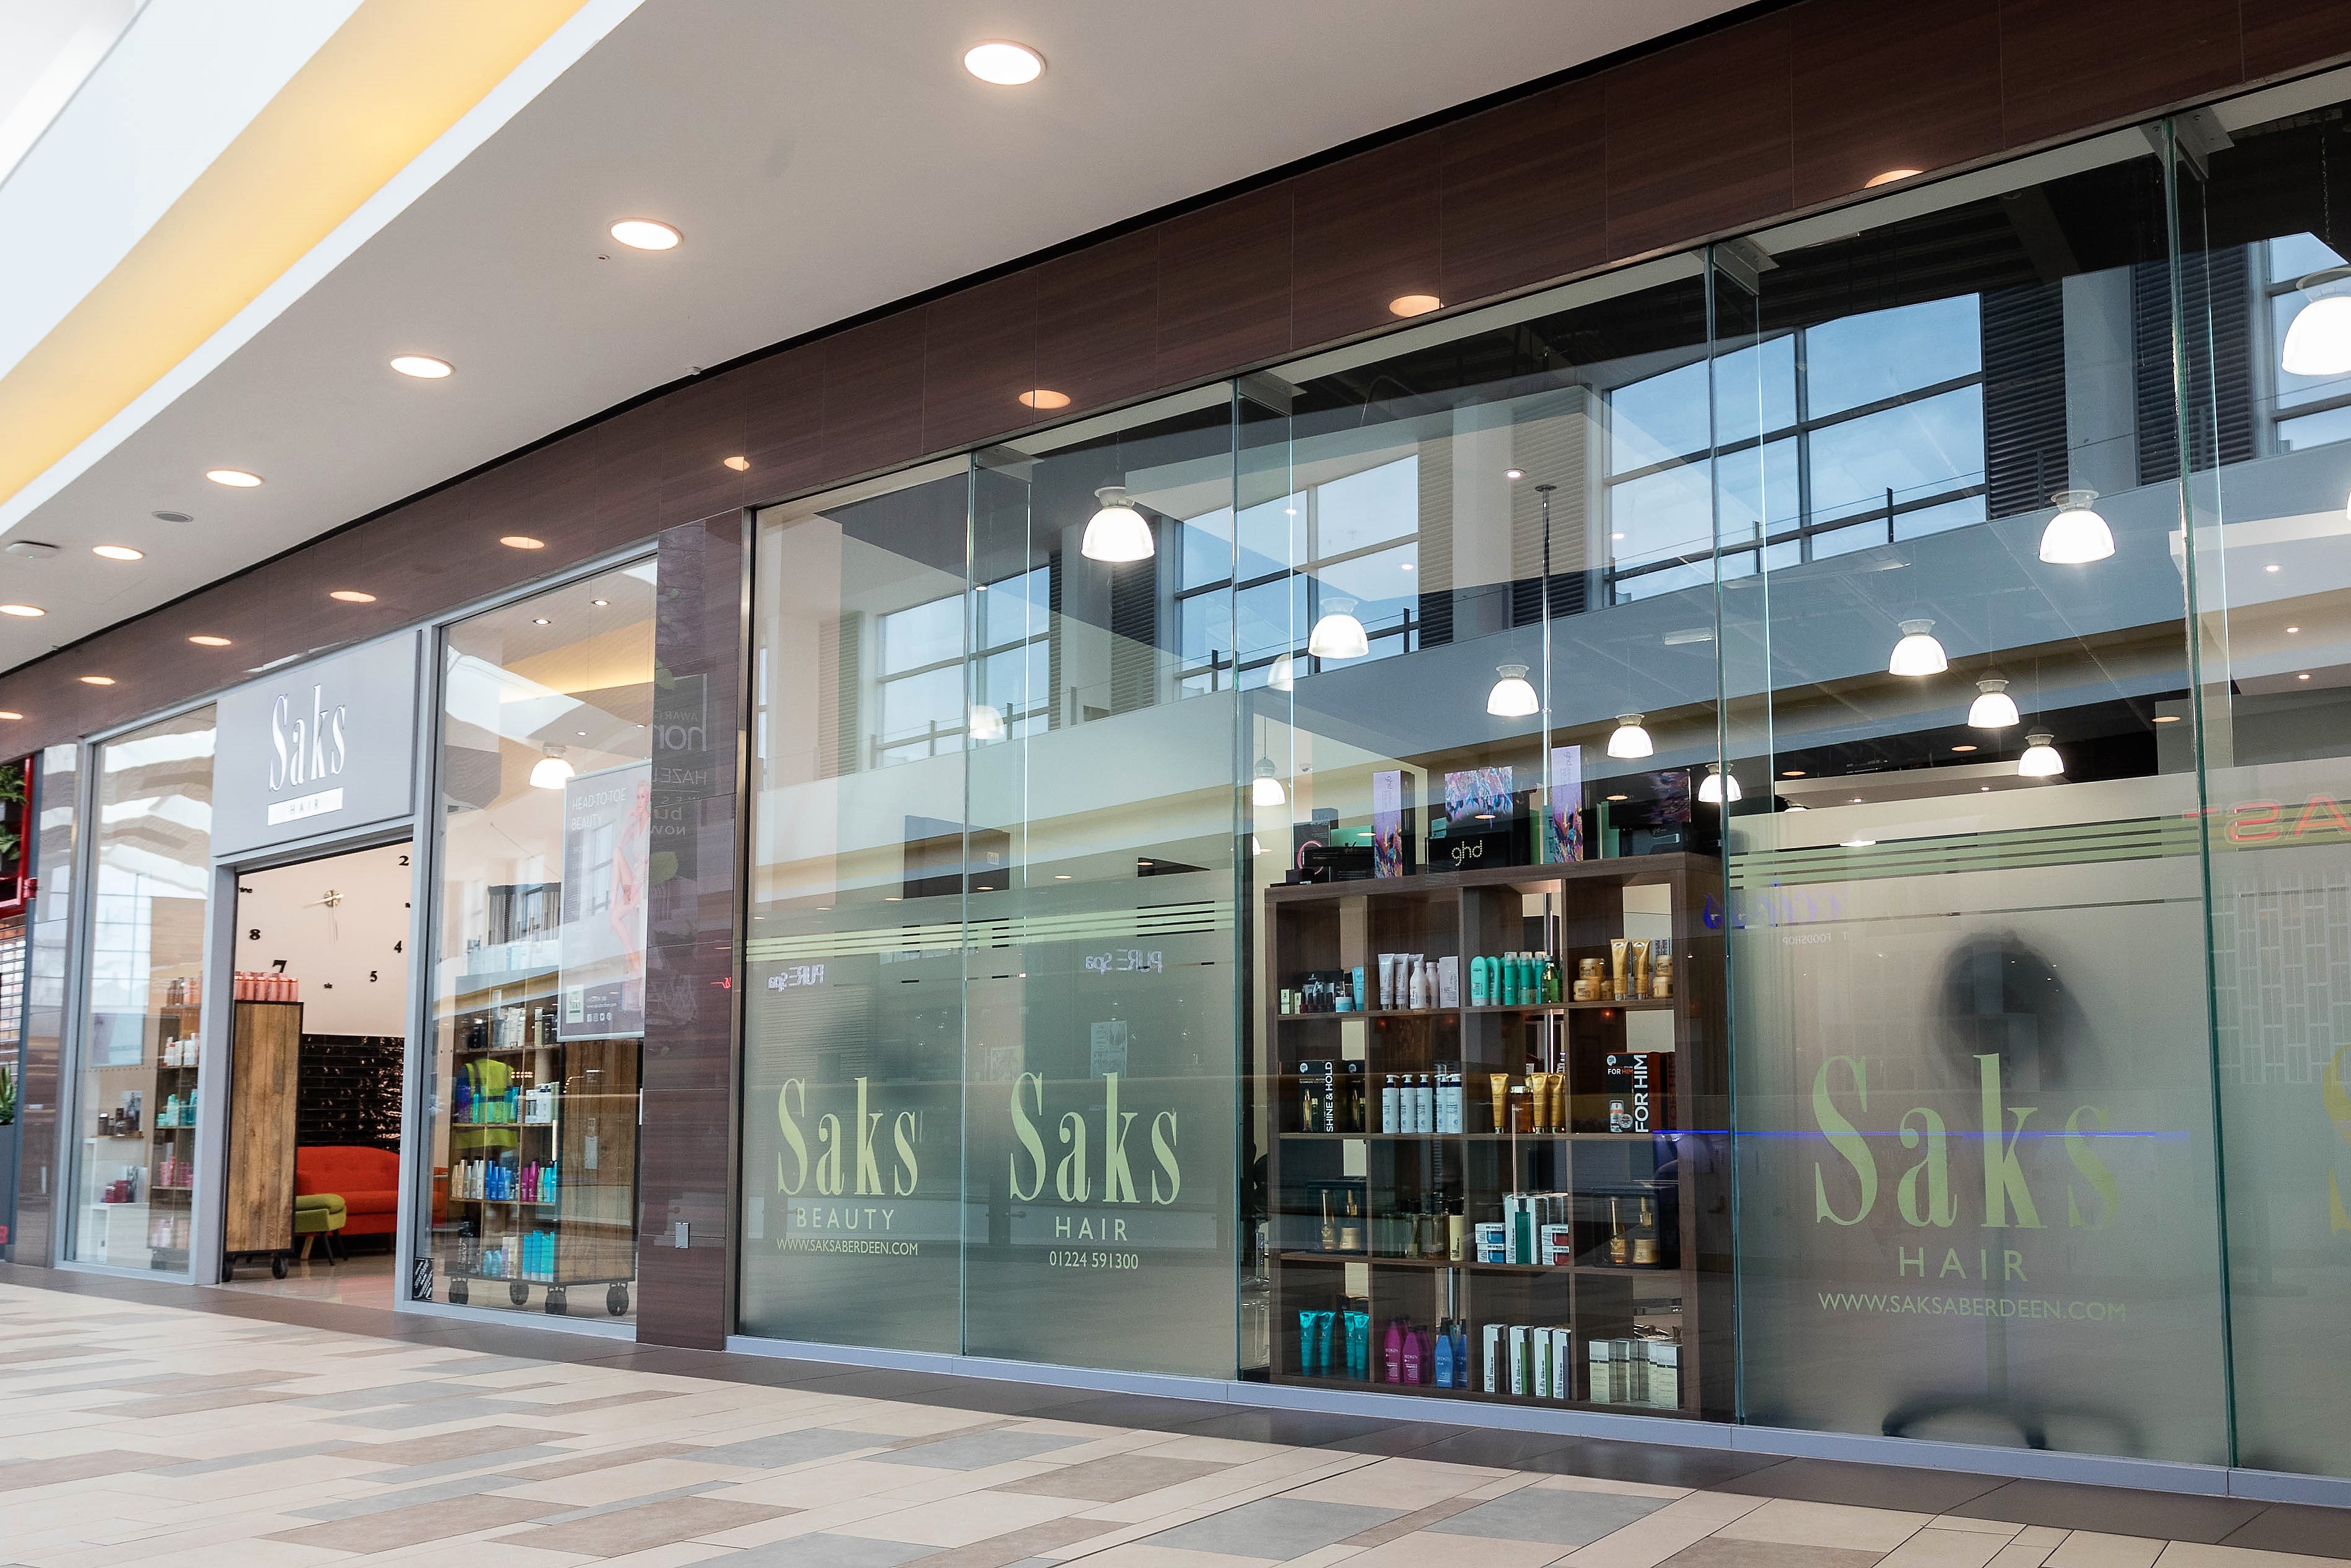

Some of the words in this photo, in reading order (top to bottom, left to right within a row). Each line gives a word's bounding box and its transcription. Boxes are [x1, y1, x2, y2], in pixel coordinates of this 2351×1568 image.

[269, 683, 346, 792] Saks
[290, 799, 319, 815] HAIR
[572, 787, 627, 811] HEAD-TO-TOE
[572, 813, 604, 830] BEAUTY
[398, 855, 409, 866] 2
[1452, 840, 1482, 866] ghd
[249, 929, 260, 940] 8
[394, 941, 402, 953] 4
[272, 959, 288, 973] 7
[370, 970, 378, 982] 5
[1325, 1061, 1333, 1091] HOLD
[1634, 1055, 1648, 1088] HIM
[1325, 1092, 1333, 1100] &
[1325, 1102, 1334, 1133] SHINE
[1635, 1092, 1648, 1133] FOR
[777, 1076, 918, 1196] Saks
[1010, 1072, 1181, 1206] Saks
[1812, 1053, 2118, 1230] Saks
[797, 1207, 895, 1230] BEAUTY
[1055, 1216, 1128, 1241] HAIR
[776, 1238, 919, 1256] WWW.SAKSABERDEEN.COM
[1049, 1251, 1087, 1267] 01224
[1092, 1253, 1139, 1269] 591300
[1899, 1246, 2028, 1282] HAIR
[1817, 1292, 2127, 1322] WWW.SAKSABERDEEN.COM
